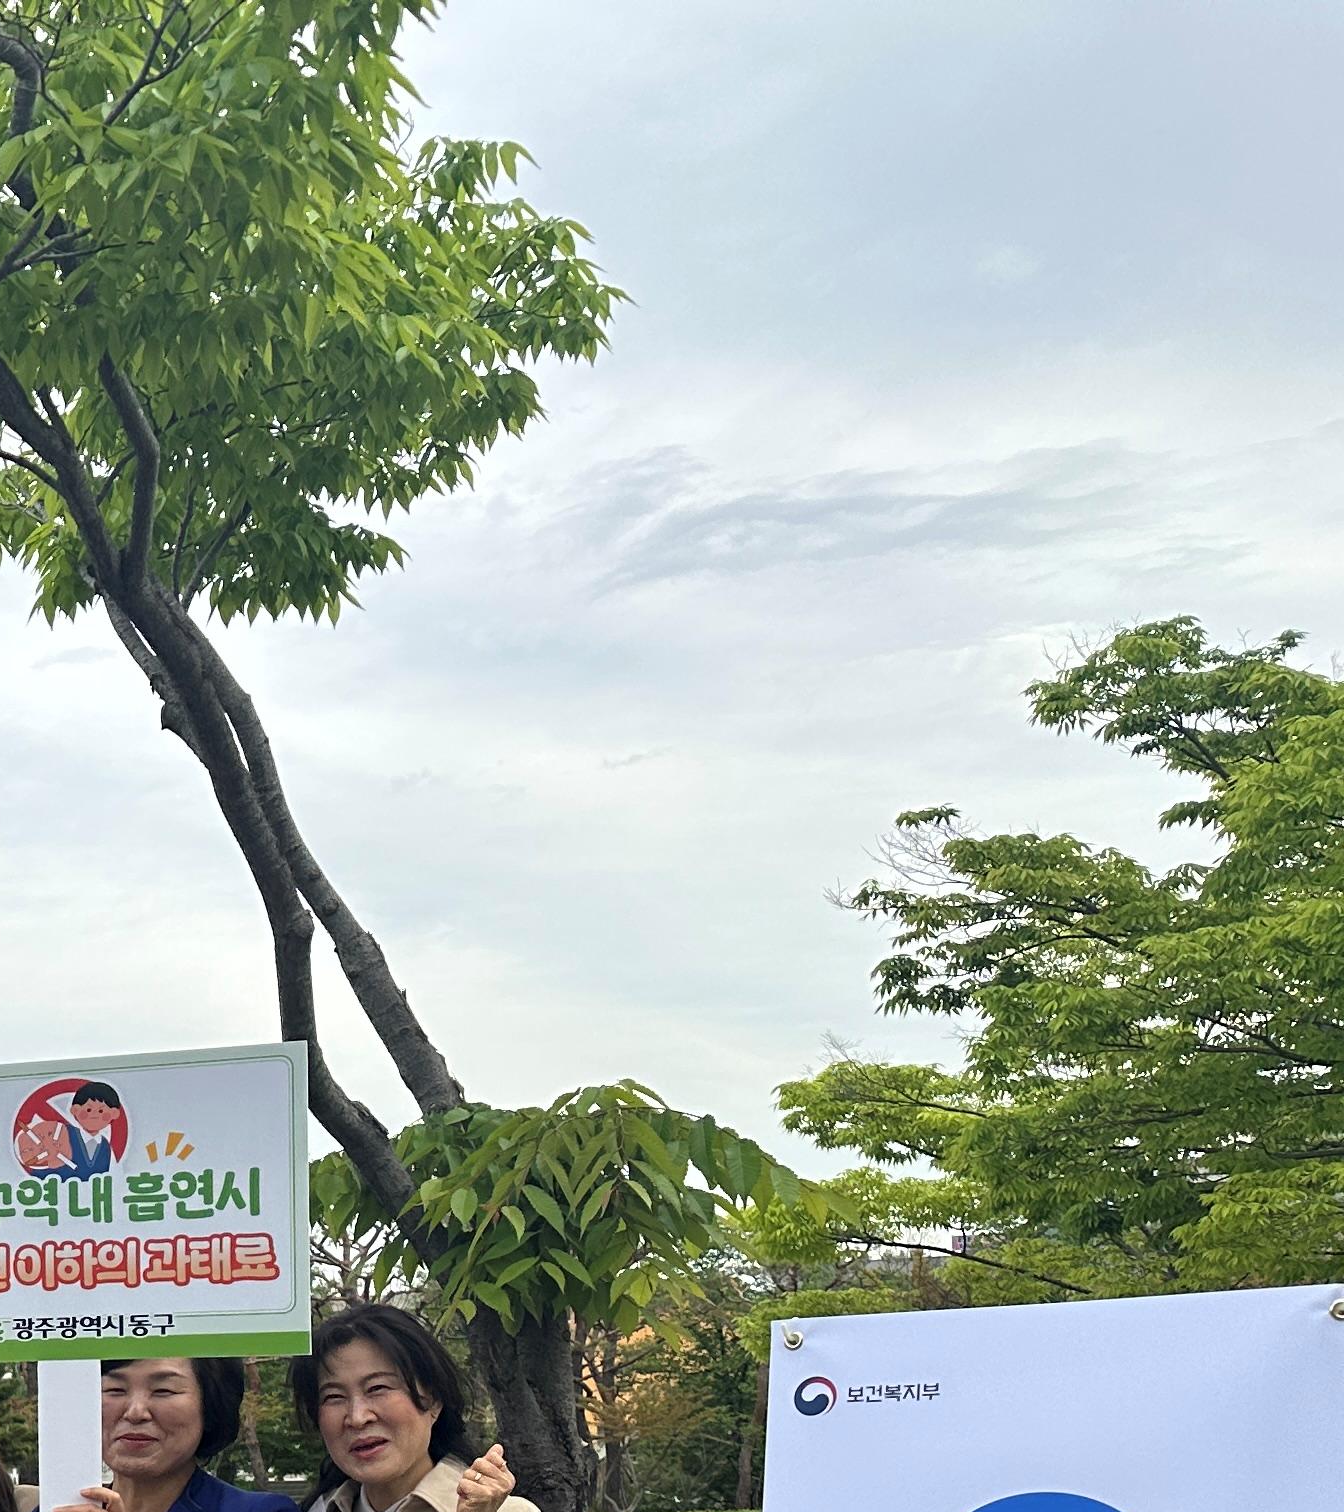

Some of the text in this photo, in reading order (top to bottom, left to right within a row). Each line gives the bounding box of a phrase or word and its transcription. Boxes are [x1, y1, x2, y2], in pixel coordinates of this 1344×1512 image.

[69, 1175, 112, 1224] 내
[123, 1167, 260, 1223] 흡연시
[13, 1236, 142, 1292] 이하의
[142, 1232, 280, 1285] 과태료
[846, 1382, 941, 1405] 보건복지부
